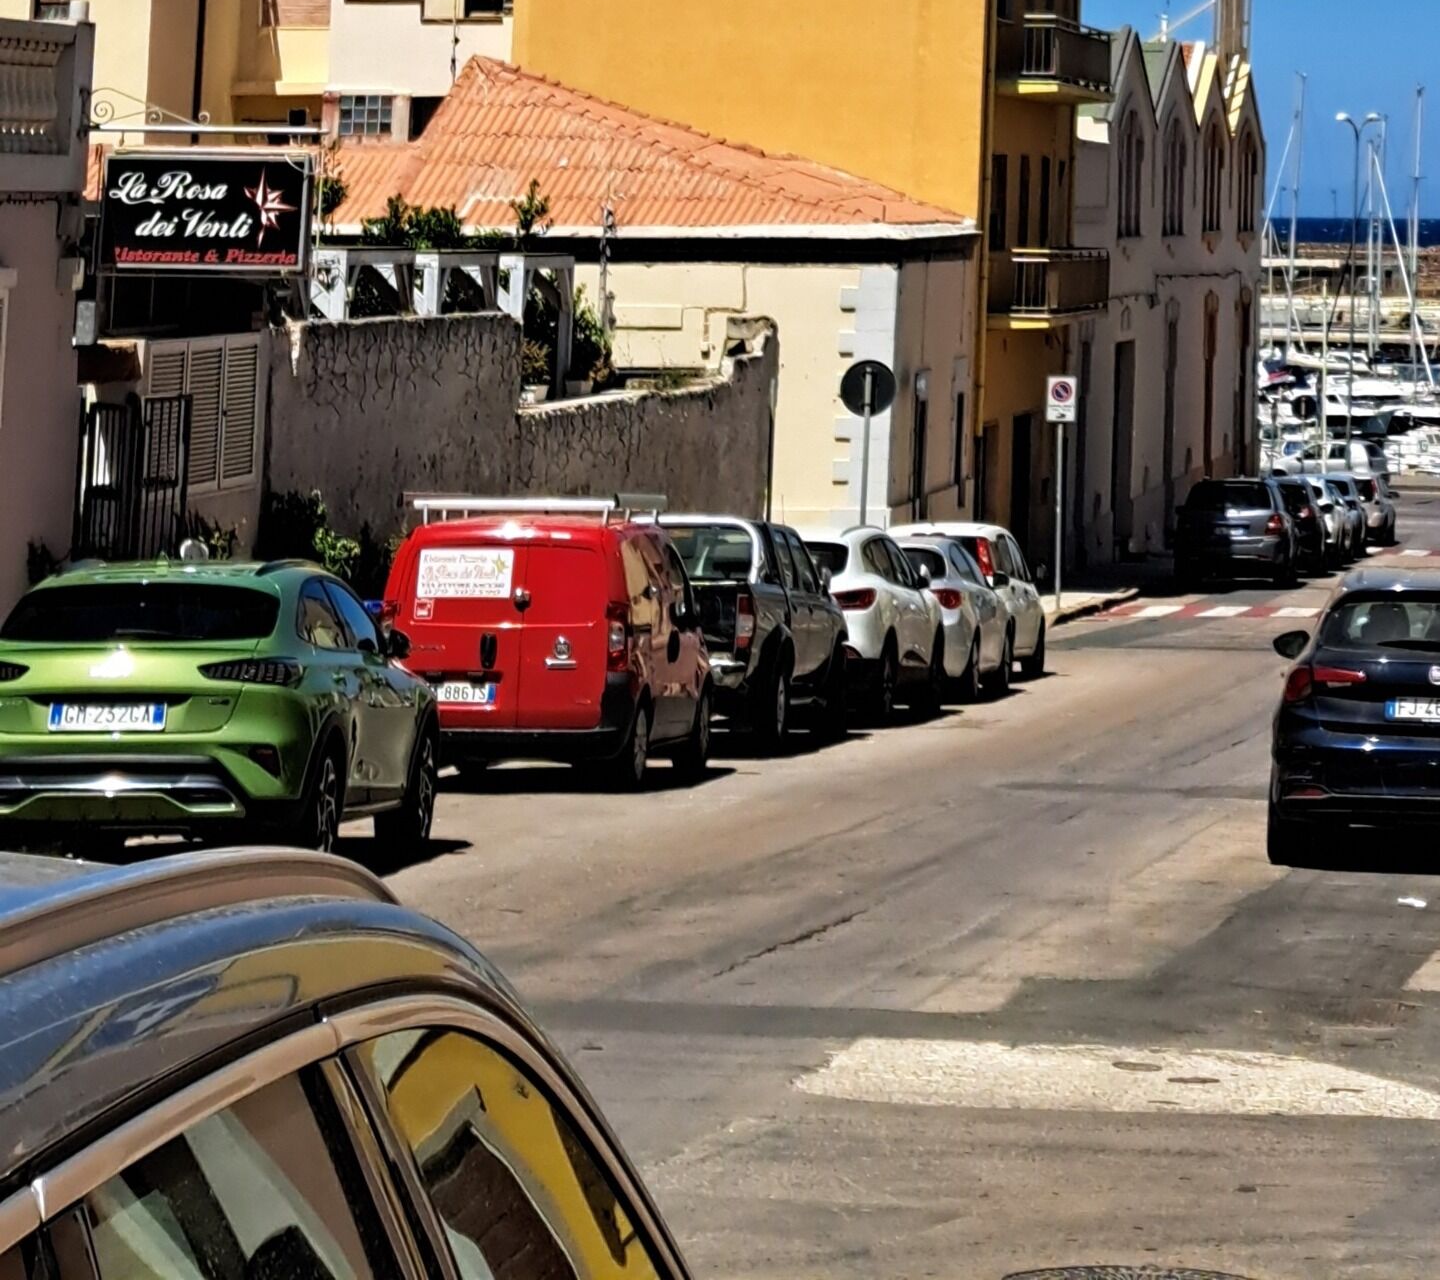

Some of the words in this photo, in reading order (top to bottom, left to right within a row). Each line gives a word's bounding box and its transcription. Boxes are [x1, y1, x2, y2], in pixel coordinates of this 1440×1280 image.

[109, 172, 156, 205] La
[151, 171, 228, 200] Rosa
[135, 210, 179, 237] dei
[182, 208, 253, 238] Venti
[204, 249, 219, 263] &
[225, 248, 296, 265] Pizzeria
